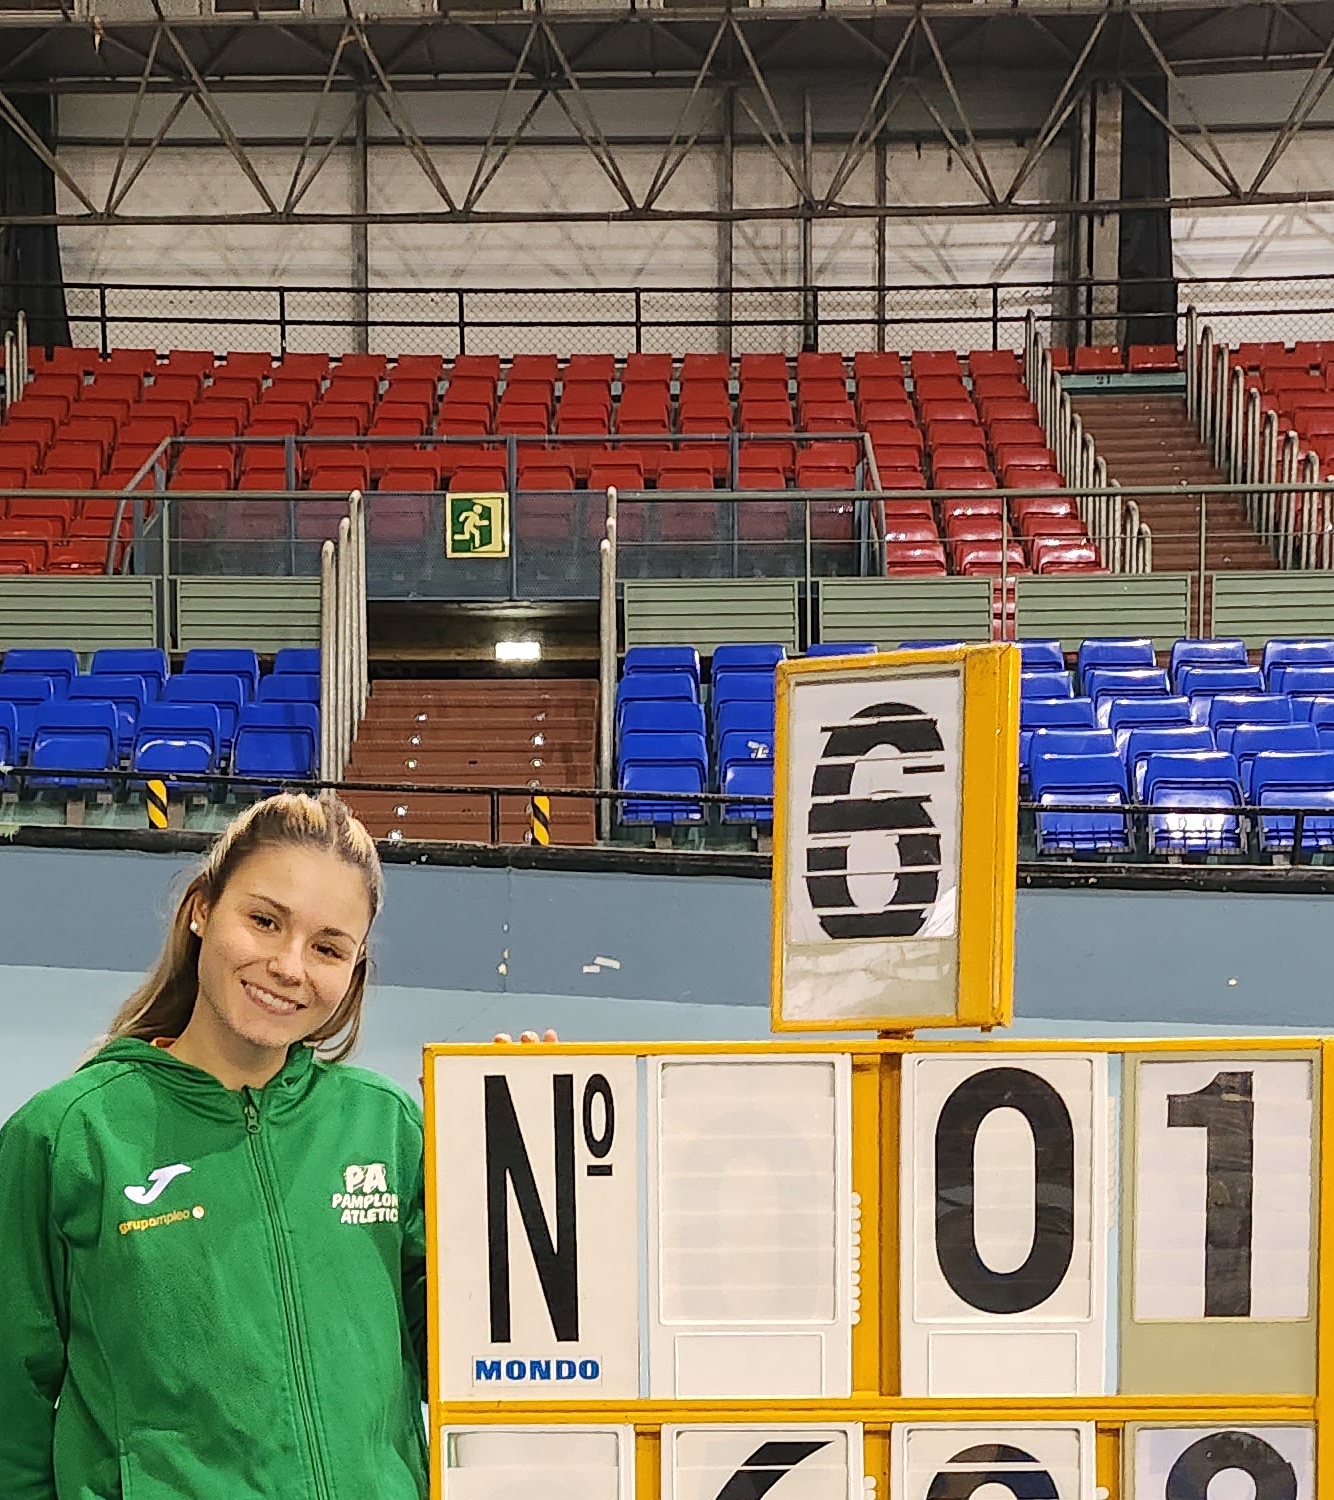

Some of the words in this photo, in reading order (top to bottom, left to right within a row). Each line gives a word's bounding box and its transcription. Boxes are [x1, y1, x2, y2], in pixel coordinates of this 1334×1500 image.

[807, 701, 943, 939] 6
[344, 1163, 387, 1193] PA
[475, 1359, 600, 1381] MONDO
